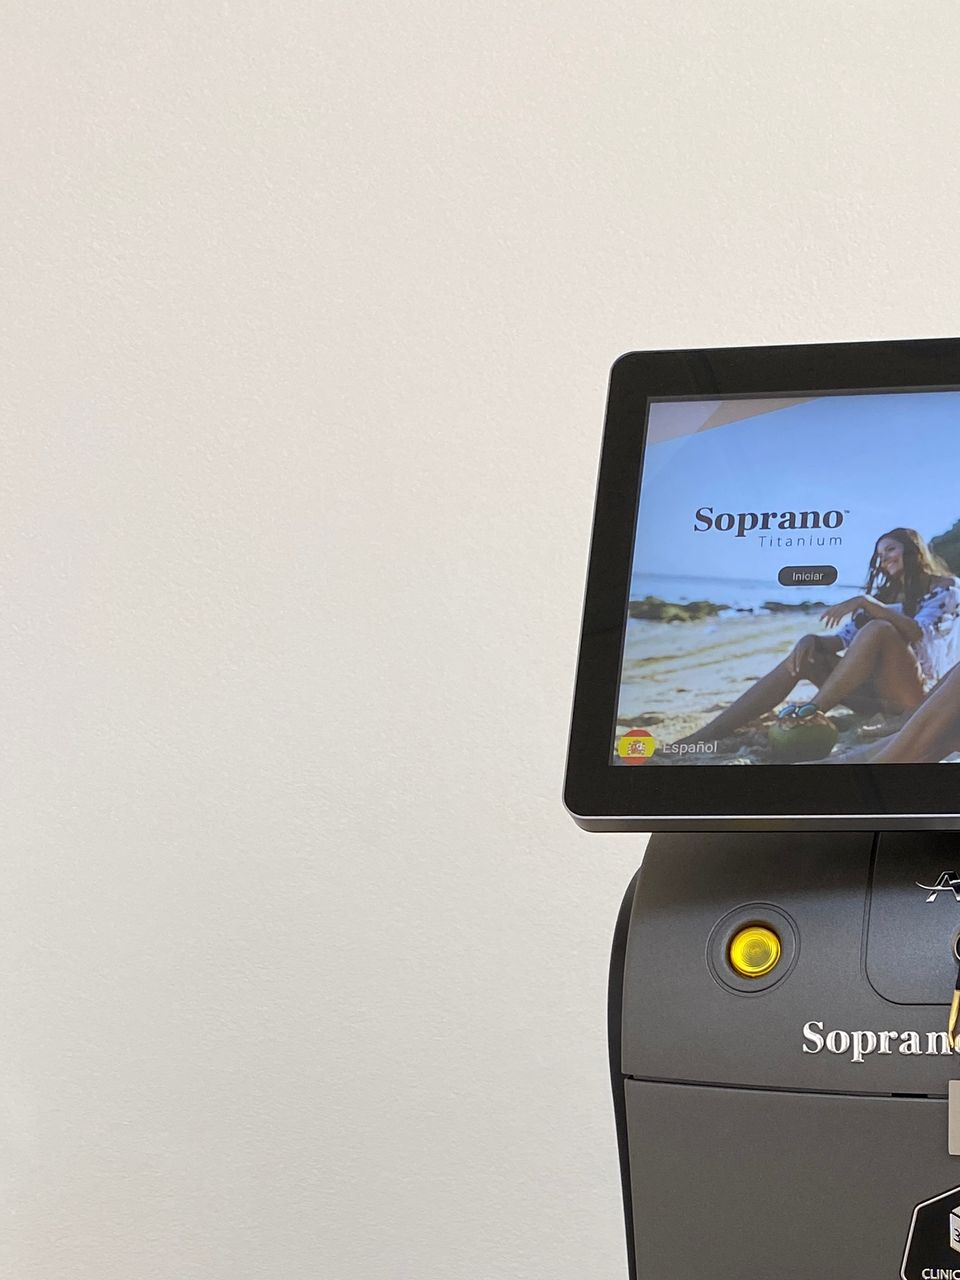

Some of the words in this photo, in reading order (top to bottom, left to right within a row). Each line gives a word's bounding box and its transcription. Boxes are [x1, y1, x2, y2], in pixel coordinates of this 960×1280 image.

[759, 535, 842, 547] Titanium
[792, 572, 824, 581] Iniciar
[663, 741, 718, 754] Español
